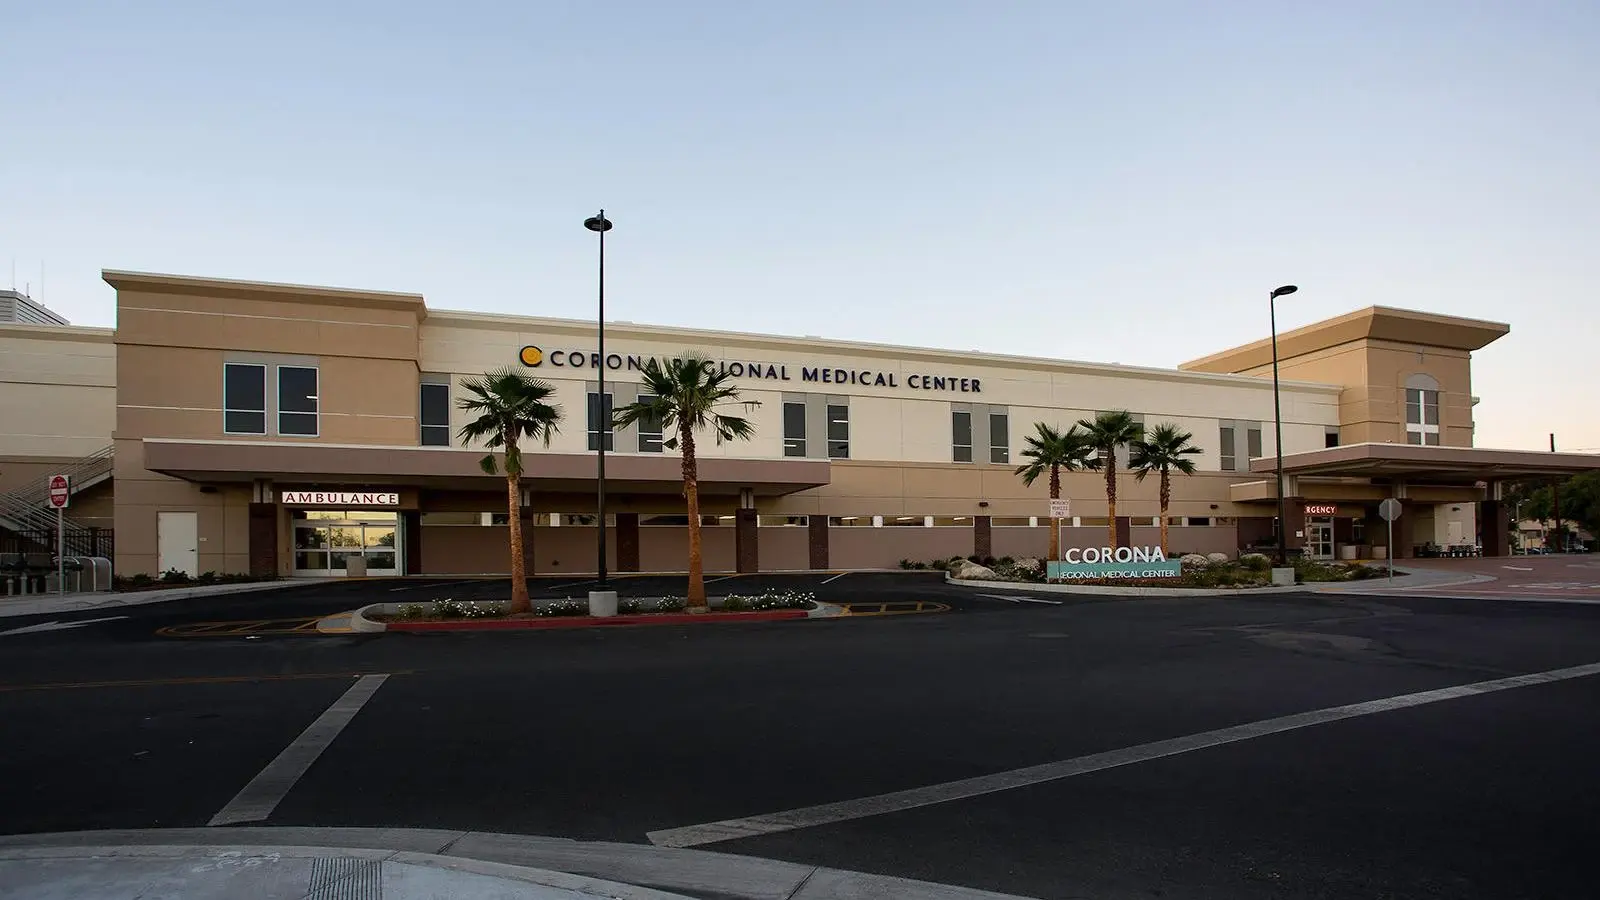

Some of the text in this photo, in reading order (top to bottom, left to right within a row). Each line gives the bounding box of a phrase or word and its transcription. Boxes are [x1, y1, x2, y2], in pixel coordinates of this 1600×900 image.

[673, 358, 791, 381] RGIONAL
[802, 366, 898, 388] MEDICAL
[907, 374, 981, 393] CENTER
[286, 493, 396, 504] AMBULANCE
[1305, 505, 1336, 514] RGENCY
[1065, 546, 1166, 564] CORONA
[1101, 570, 1141, 579] MEDICAL
[1142, 569, 1175, 578] CENTER
